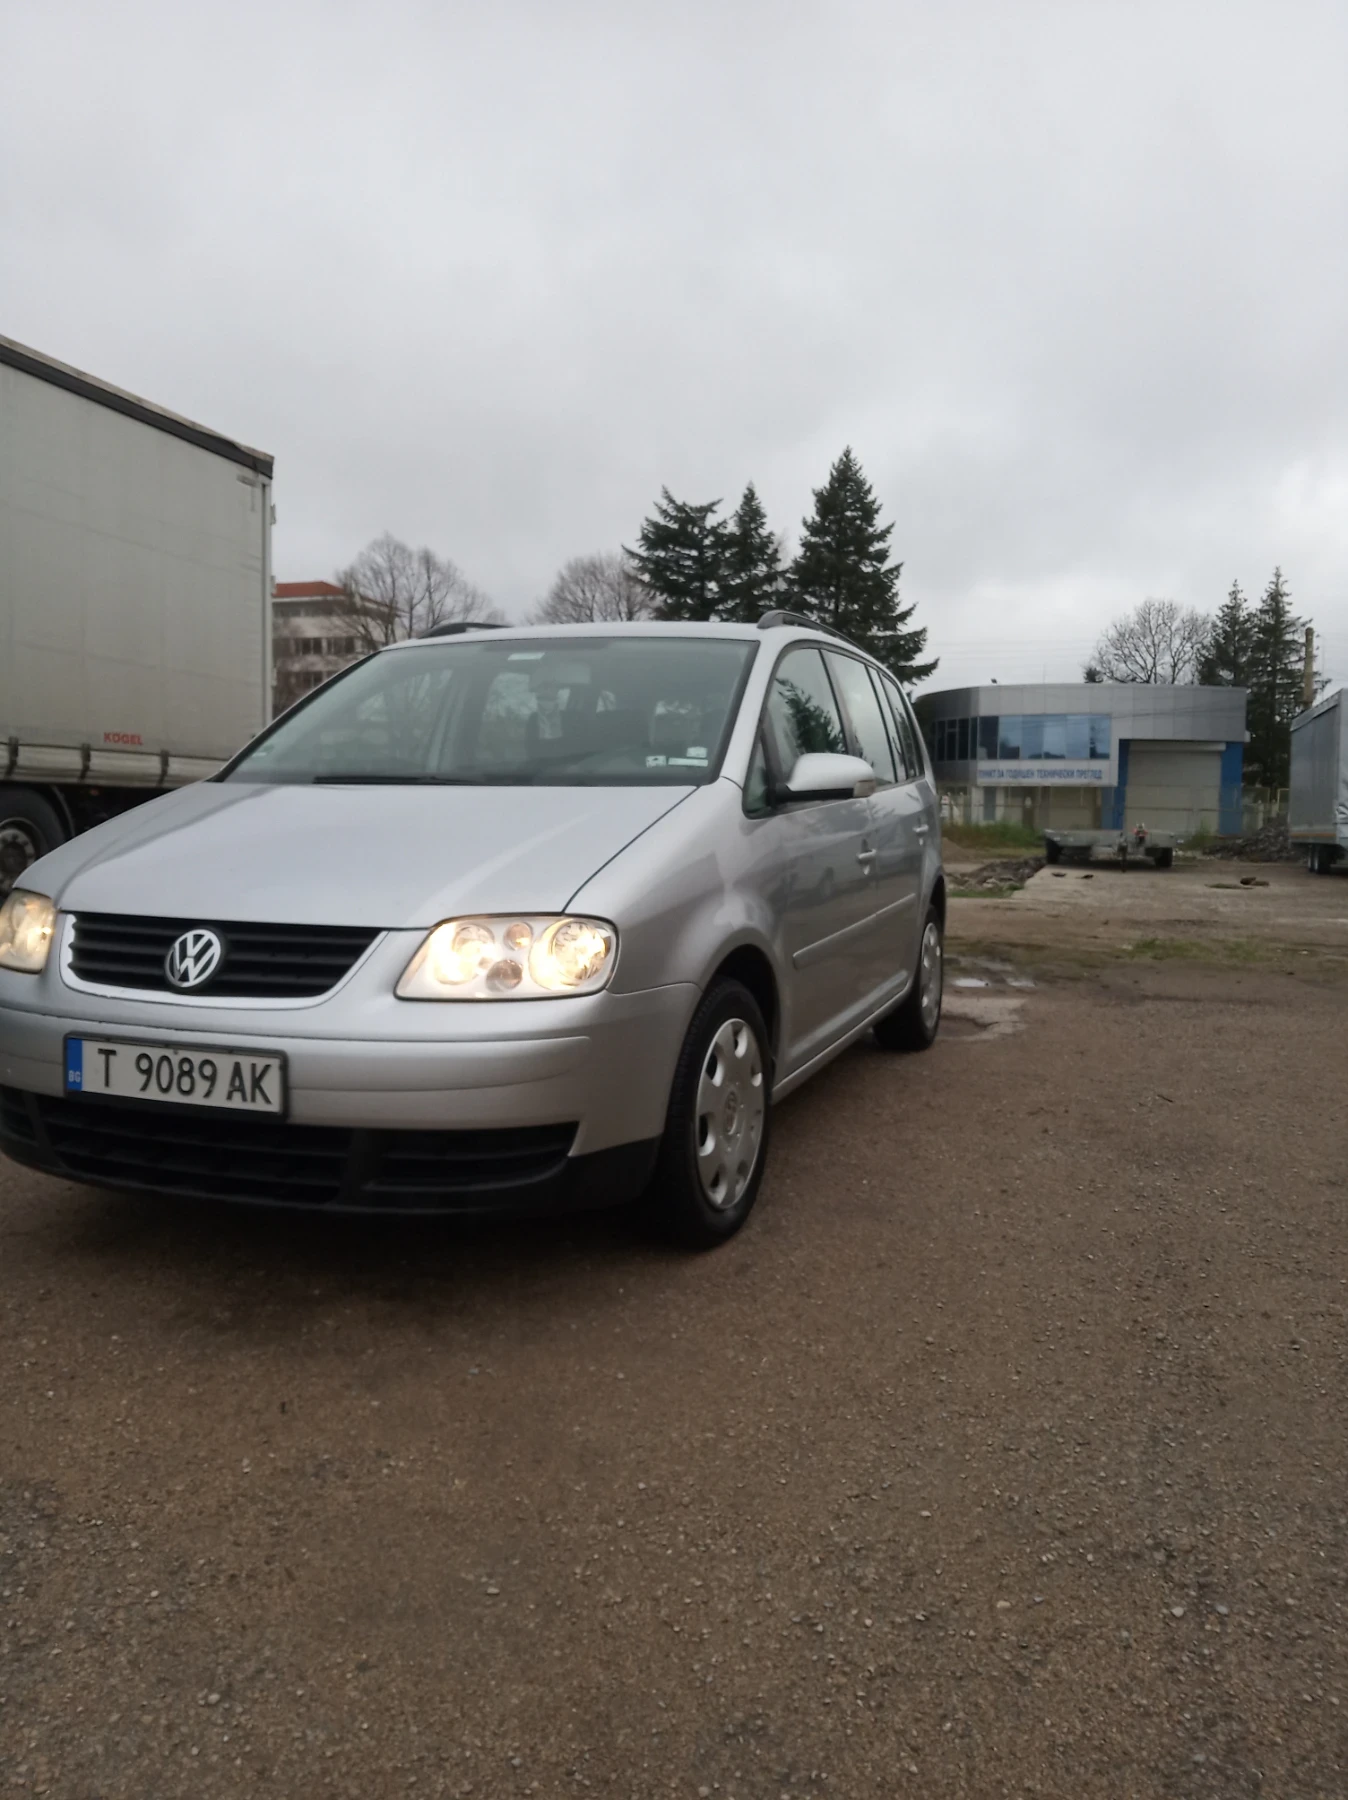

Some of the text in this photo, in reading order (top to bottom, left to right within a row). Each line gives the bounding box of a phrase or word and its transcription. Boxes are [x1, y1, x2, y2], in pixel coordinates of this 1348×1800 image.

[68, 1069, 82, 1083] BG
[97, 1048, 272, 1105] T 9089 AK
